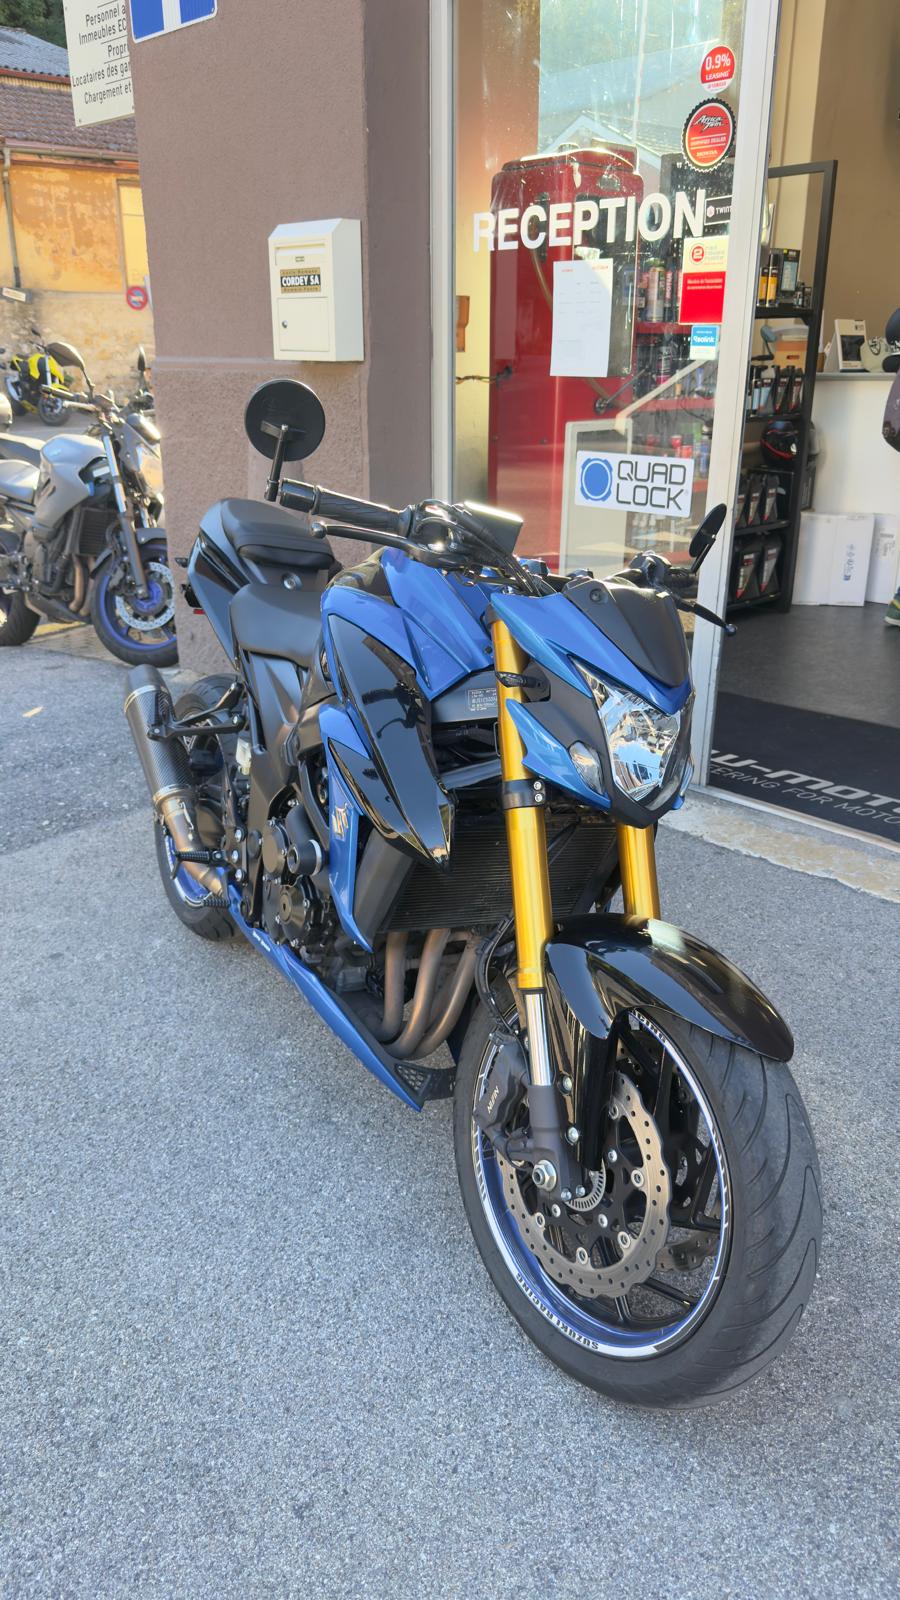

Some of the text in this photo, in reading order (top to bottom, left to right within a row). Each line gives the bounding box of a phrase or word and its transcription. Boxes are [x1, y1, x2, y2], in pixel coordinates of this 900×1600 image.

[86, 3, 120, 27] Personnel
[79, 24, 117, 45] Immeubles
[107, 43, 128, 58] Propr
[705, 53, 731, 71] 0.9%
[72, 69, 105, 88] Locataires
[107, 63, 119, 78] des
[84, 80, 132, 104] Chargement et
[473, 189, 706, 253] RECEPTION
[281, 274, 320, 287] CORDEY SA
[617, 460, 687, 485] QUAD
[616, 482, 684, 510] LOCK
[781, 788, 834, 804] FOR
[516, 1272, 599, 1350] SUZUKI RACING
